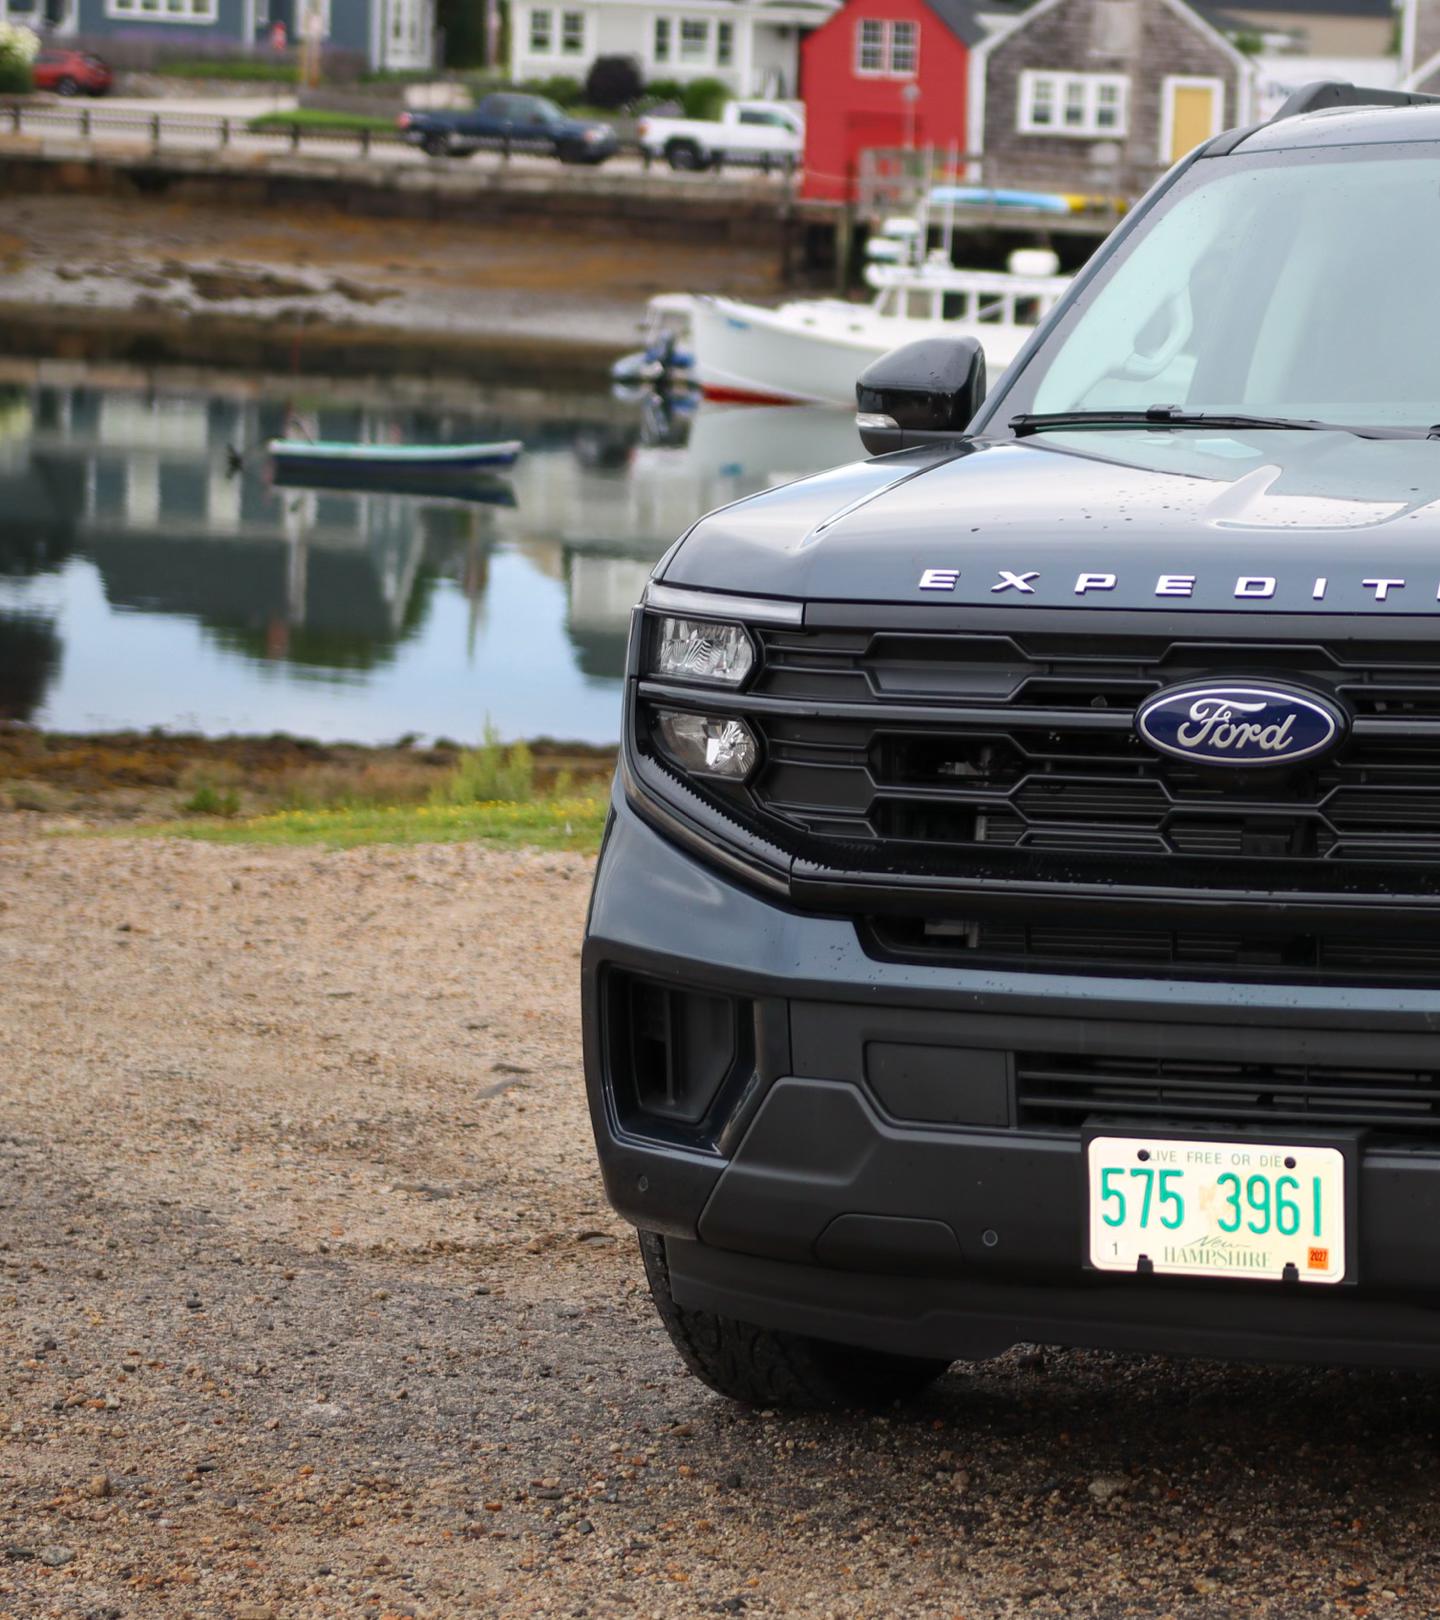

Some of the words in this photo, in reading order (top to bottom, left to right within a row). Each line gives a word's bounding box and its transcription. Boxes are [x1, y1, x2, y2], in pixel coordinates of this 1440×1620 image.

[1177, 698, 1296, 750] Ford
[1187, 1151, 1222, 1164] FREE
[1231, 1153, 1250, 1166] OR
[1260, 1155, 1282, 1168] DIE
[1101, 1168, 1184, 1229] 575
[1217, 1173, 1321, 1237] 3961
[1111, 1242, 1118, 1255] 1
[1183, 1235, 1250, 1248] New
[1164, 1246, 1270, 1267] HAMPSHIRE
